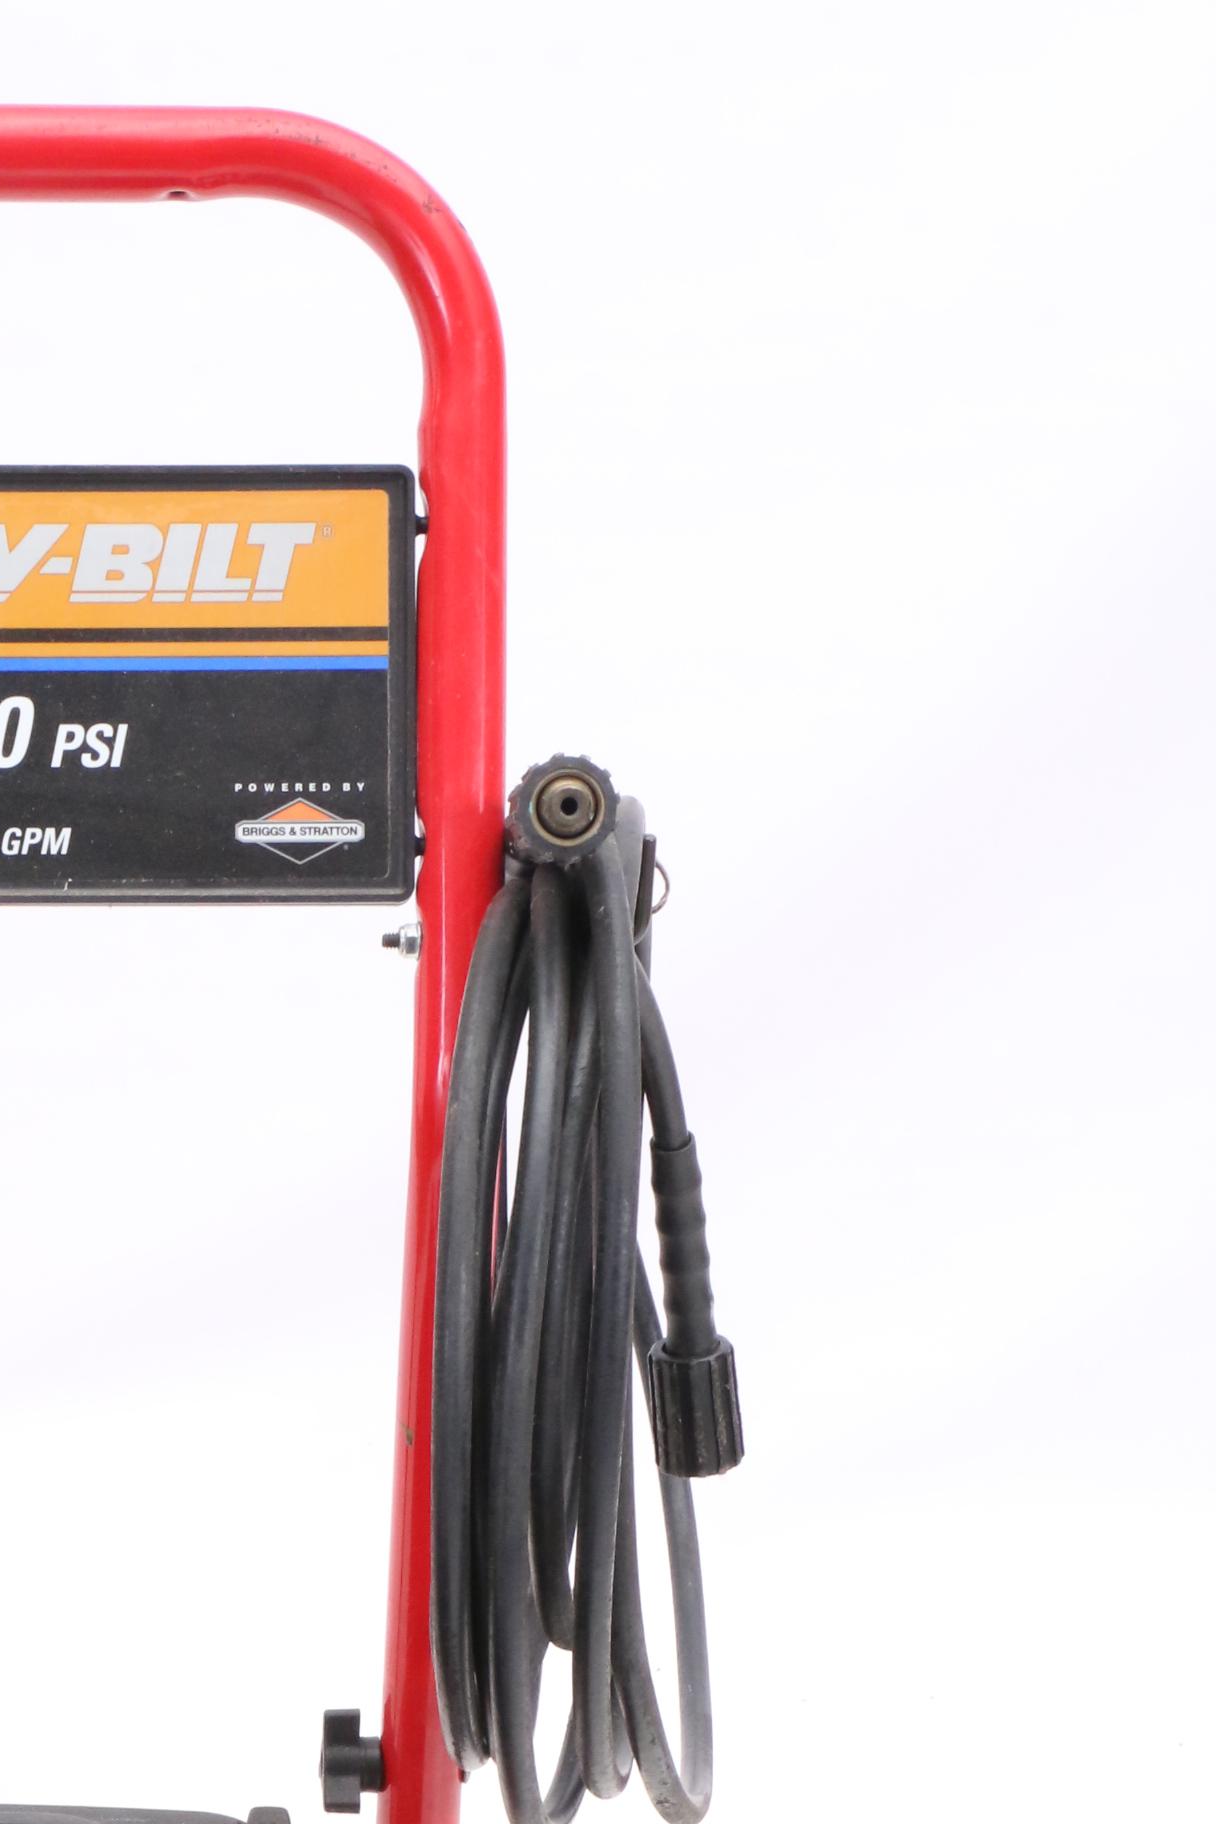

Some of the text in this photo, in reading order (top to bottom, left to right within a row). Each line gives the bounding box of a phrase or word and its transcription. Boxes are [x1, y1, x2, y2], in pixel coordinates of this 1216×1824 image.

[50, 723, 128, 768] PSI
[234, 782, 365, 792] POWERED BY
[242, 826, 358, 836] BRIGGS & STRATTON
[0, 827, 71, 857] GPM
